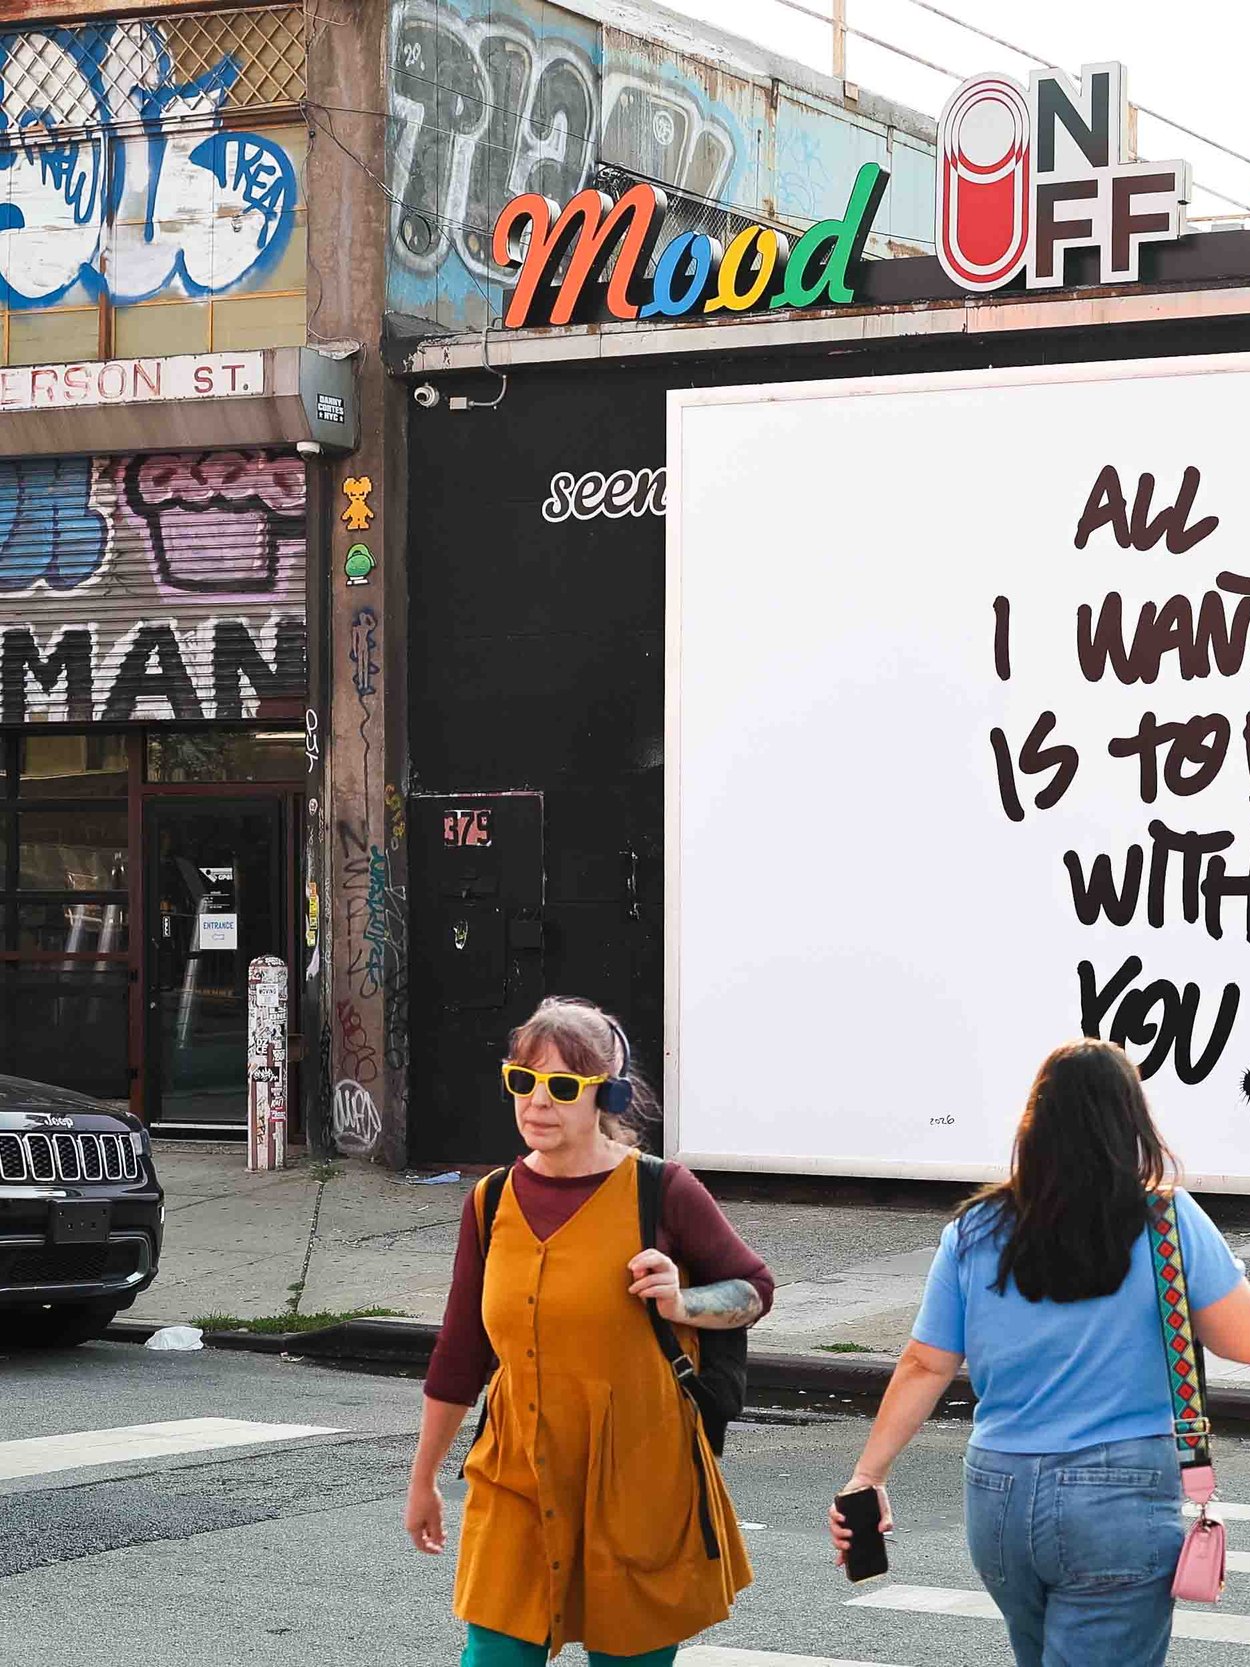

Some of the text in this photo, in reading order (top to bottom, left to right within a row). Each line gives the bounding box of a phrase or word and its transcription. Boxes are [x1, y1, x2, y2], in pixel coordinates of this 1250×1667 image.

[494, 163, 890, 328] Mood
[318, 403, 344, 415] CORTES
[320, 395, 342, 406] DANNY
[324, 412, 339, 421] NYC
[541, 466, 666, 523] seen
[1074, 465, 1219, 554] ALL
[993, 596, 1010, 681] I
[990, 711, 1079, 822] IS
[1108, 712, 1230, 803] TO
[443, 809, 492, 846] 379
[203, 922, 234, 931] ENTRANCE
[44, 1114, 73, 1128] Jeep
[930, 1114, 955, 1126] 2026
